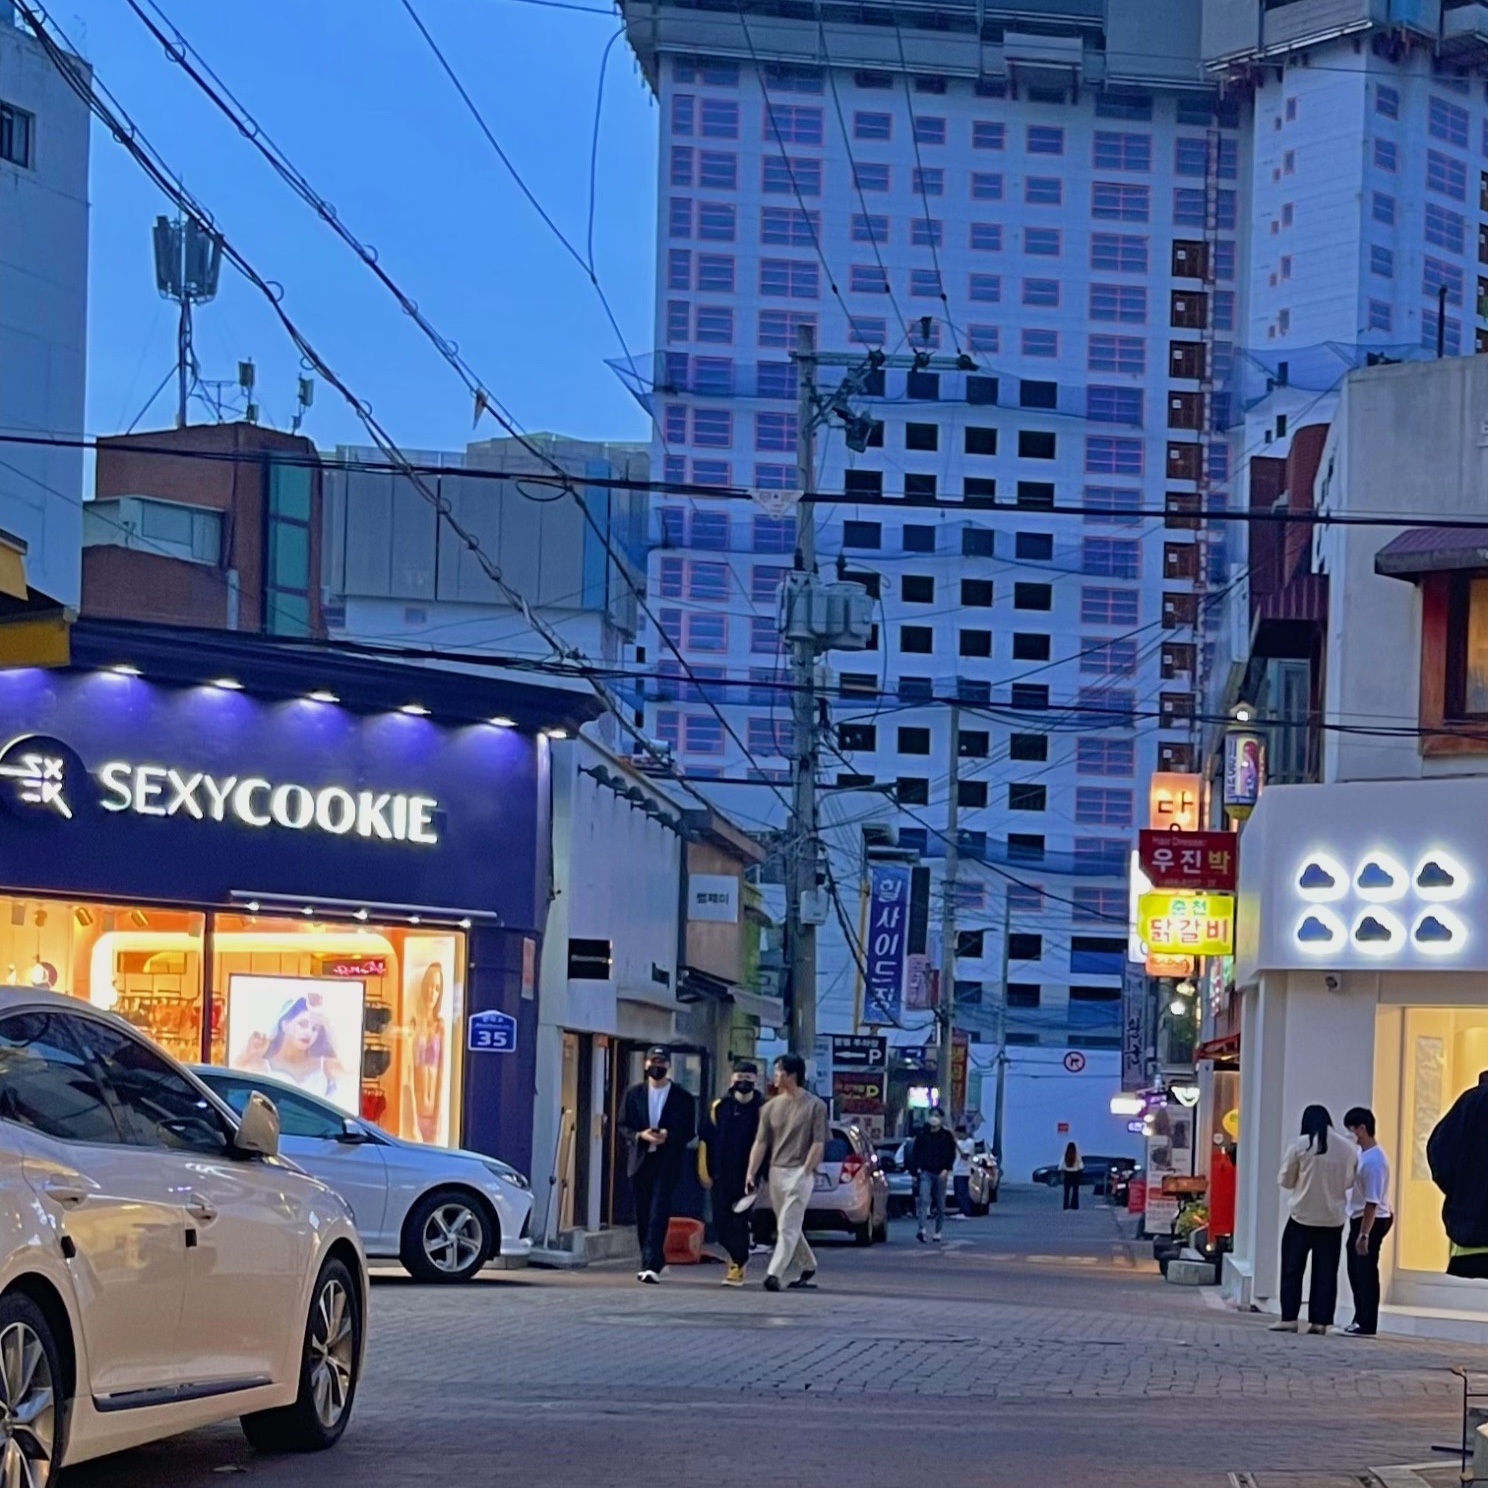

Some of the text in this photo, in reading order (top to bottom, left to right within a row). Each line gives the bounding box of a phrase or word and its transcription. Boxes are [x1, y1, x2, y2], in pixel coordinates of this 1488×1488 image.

[100, 762, 439, 845] SEXYCOOKIE
[1150, 918, 1229, 944] 닭갈비
[477, 1030, 508, 1047] 35
[868, 1048, 882, 1065] P
